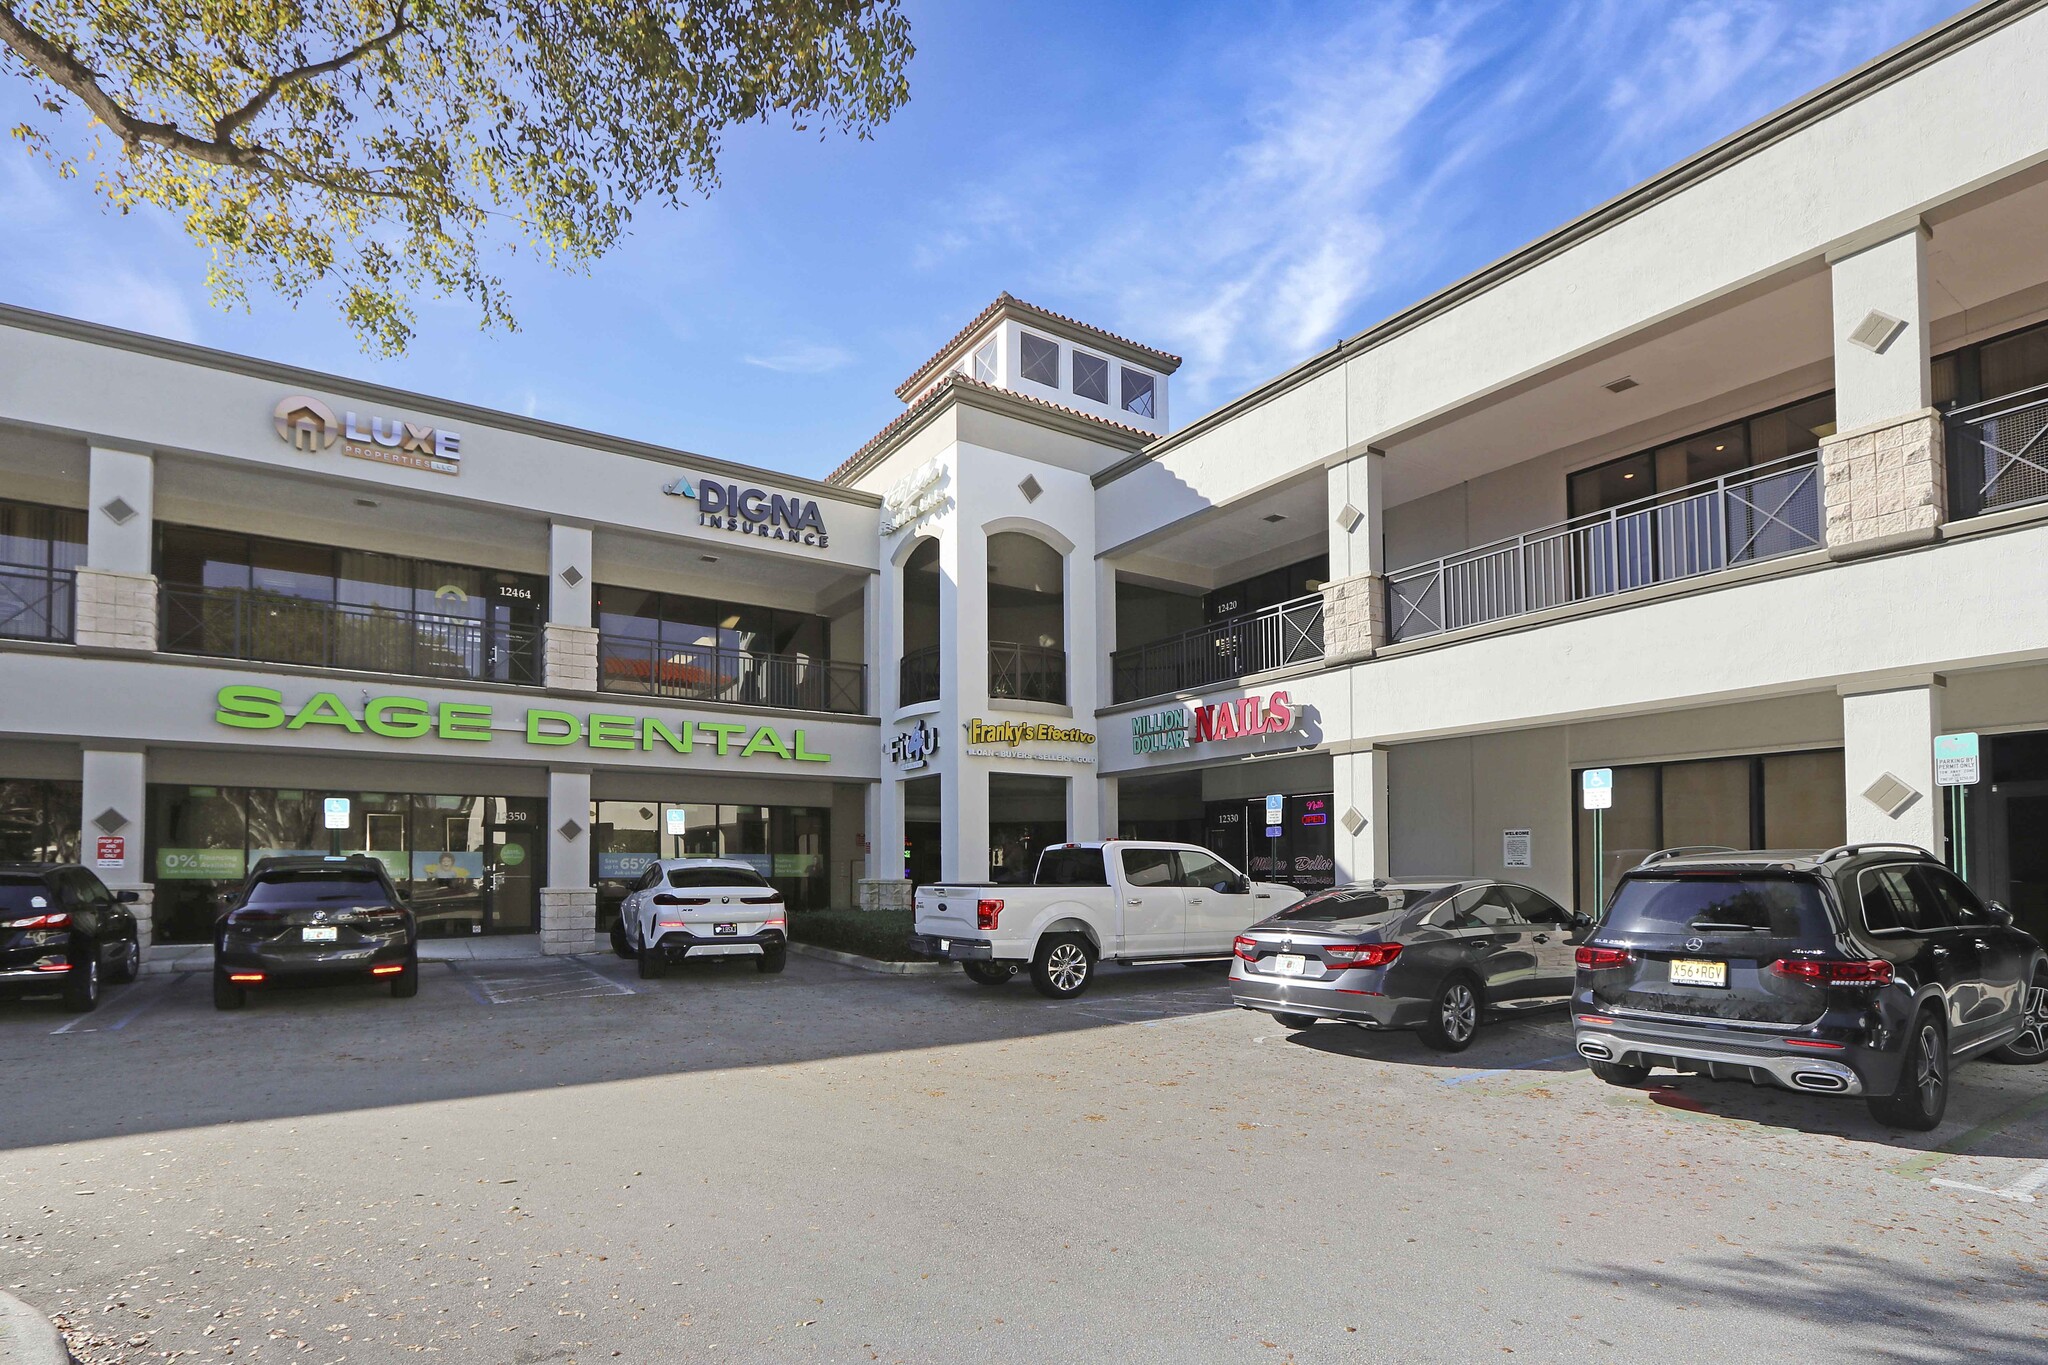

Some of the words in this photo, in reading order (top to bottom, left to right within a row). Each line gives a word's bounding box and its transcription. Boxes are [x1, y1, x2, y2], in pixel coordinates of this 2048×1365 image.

[345, 411, 461, 461] LUXE
[345, 445, 431, 468] PROPERTIES
[435, 463, 453, 472] LLC
[699, 478, 827, 535] DIGNA
[700, 513, 829, 549] INSURANCE
[500, 586, 532, 600] 12464
[1218, 600, 1238, 614] 12420
[215, 684, 493, 742] SAGE
[526, 708, 832, 763] DENTAL
[1131, 708, 1185, 736] MILLION
[1194, 690, 1292, 744] NAILS
[971, 718, 1035, 748] Franky's
[1132, 730, 1186, 755] DOLLAR
[1001, 751, 1033, 760] BUYERS
[1039, 754, 1071, 763] SELLERS
[1219, 813, 1239, 824] 12330
[1302, 815, 1324, 824] OPEN
[165, 854, 198, 868] 0%
[199, 854, 238, 862] Financing
[620, 858, 652, 870] 65%
[1295, 854, 1334, 872] Dollar
